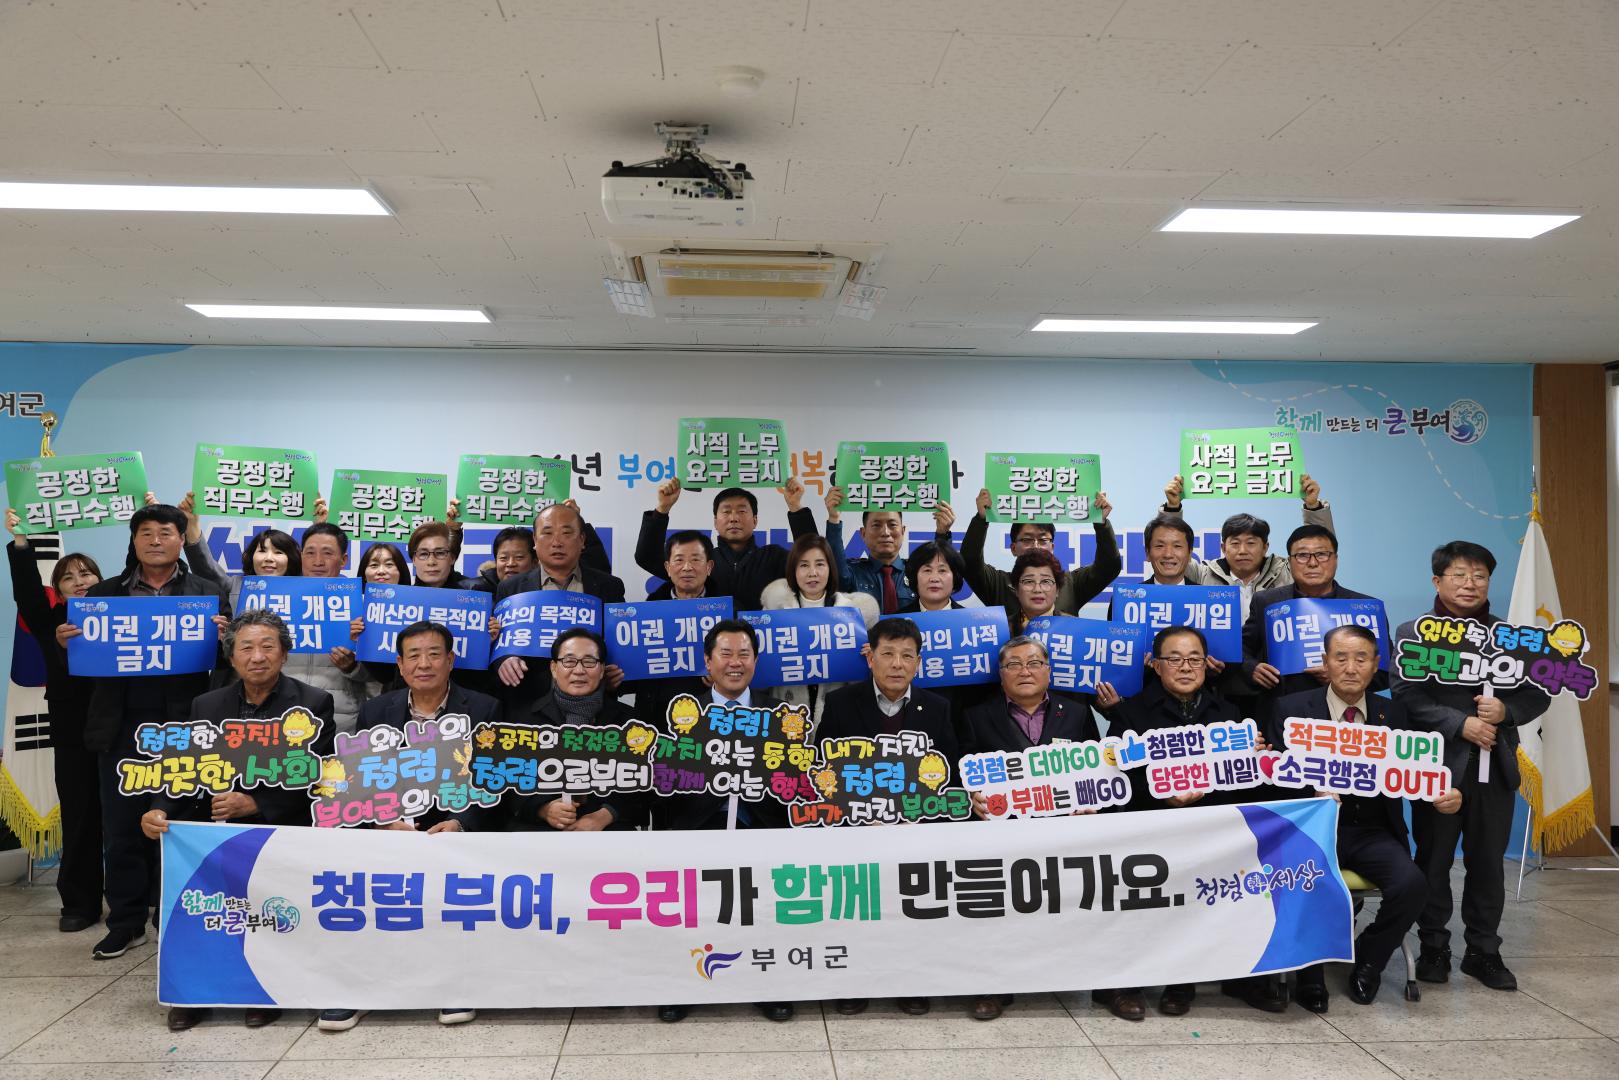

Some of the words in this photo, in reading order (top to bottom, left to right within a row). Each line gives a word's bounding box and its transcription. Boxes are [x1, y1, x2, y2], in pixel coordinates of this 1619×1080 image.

[1276, 407, 1322, 432] 함께
[1327, 418, 1361, 433] 만드는
[1366, 418, 1378, 432] 더
[1383, 408, 1406, 436] 큰
[1410, 409, 1450, 435] 부여
[687, 432, 729, 457] 사적
[738, 432, 779, 456] 노무
[1190, 443, 1236, 469] 사적
[1246, 443, 1293, 468] 노무
[35, 466, 119, 498] 공정한
[216, 458, 293, 488] 공정한
[478, 467, 548, 495] 공정한
[617, 453, 677, 489] 부여
[686, 460, 730, 484] 요구
[738, 460, 781, 484] 금지
[859, 455, 928, 482] 공정한
[1009, 466, 1079, 493] 공정한
[1190, 469, 1237, 495] 요구
[1246, 469, 1293, 495] 금지
[203, 486, 305, 517] 직무수행
[351, 483, 425, 512] 공정한
[847, 482, 938, 509] 직무수행
[997, 494, 1090, 522] 직무수행
[25, 494, 136, 529] 직무수행
[245, 594, 291, 619] 이권
[302, 595, 351, 621] 개입
[367, 602, 423, 625] 예산의
[428, 606, 485, 632] 목적외
[539, 606, 596, 625] 목적외
[1124, 602, 1172, 629] 이권
[1184, 603, 1231, 630] 개입
[82, 616, 139, 643] 이권
[155, 615, 205, 641] 개입
[495, 628, 531, 648] 사용
[616, 619, 664, 647] 이권
[675, 616, 722, 644] 개입
[756, 626, 799, 654] 이권
[808, 623, 857, 650] 개입
[960, 625, 998, 647] 사적
[1273, 615, 1320, 642] 이권
[1418, 619, 1487, 646] 일상속
[1495, 626, 1550, 654] 청렴,
[116, 646, 172, 673] 금지
[647, 647, 696, 675] 금지
[951, 653, 991, 677] 금지
[1084, 637, 1134, 666] 개입
[781, 654, 830, 682] 금지
[1052, 663, 1101, 689] 금지
[1400, 643, 1523, 681] 군민과의
[1530, 660, 1596, 693] 약속
[336, 727, 402, 756] 너와
[405, 715, 470, 744] 나의
[707, 707, 770, 737] 청렴!
[140, 725, 217, 752] 청렴한
[224, 722, 279, 748] 공직!
[499, 728, 559, 751] 공직의
[825, 740, 875, 760] 내가
[879, 733, 926, 757] 지킨
[1148, 730, 1206, 760] 청렴한
[1210, 724, 1254, 753] 오늘!
[1289, 722, 1388, 760] 적극행정
[1395, 737, 1439, 763] UP!
[358, 748, 450, 790] 청렴,
[656, 737, 702, 761] 가치
[705, 738, 755, 763] 있는
[762, 741, 815, 772] 동행
[964, 755, 1024, 786] 청렴은
[1029, 745, 1100, 777] 더하GO
[122, 753, 235, 793] 깨끗한
[245, 750, 318, 786] 사회
[473, 756, 648, 791] 청렴으로부터
[653, 763, 705, 790] 함께
[713, 771, 763, 796] 여는
[842, 762, 917, 794] 청렴,
[1151, 763, 1211, 793] 당당한
[1214, 756, 1259, 786] 내일!
[1277, 755, 1377, 791] 소극행정
[1384, 767, 1446, 797] OUT!
[315, 788, 431, 827] 부여군의
[791, 803, 842, 826] 내가
[849, 797, 895, 821] 지킨
[902, 790, 969, 822] 부여군
[1012, 786, 1070, 815] 부패는
[1075, 777, 1126, 805] 빼GO
[183, 892, 223, 913] 함께
[226, 898, 252, 910] 만드는
[312, 870, 425, 932] 청렴
[441, 873, 571, 935] 부여,
[587, 867, 758, 930] 우리가
[771, 863, 881, 925] 함께
[898, 853, 1185, 920] 만들어가요.
[206, 916, 221, 929] 더
[224, 912, 243, 933] 큰
[246, 914, 276, 933] 부여
[751, 944, 849, 972] 부여군
